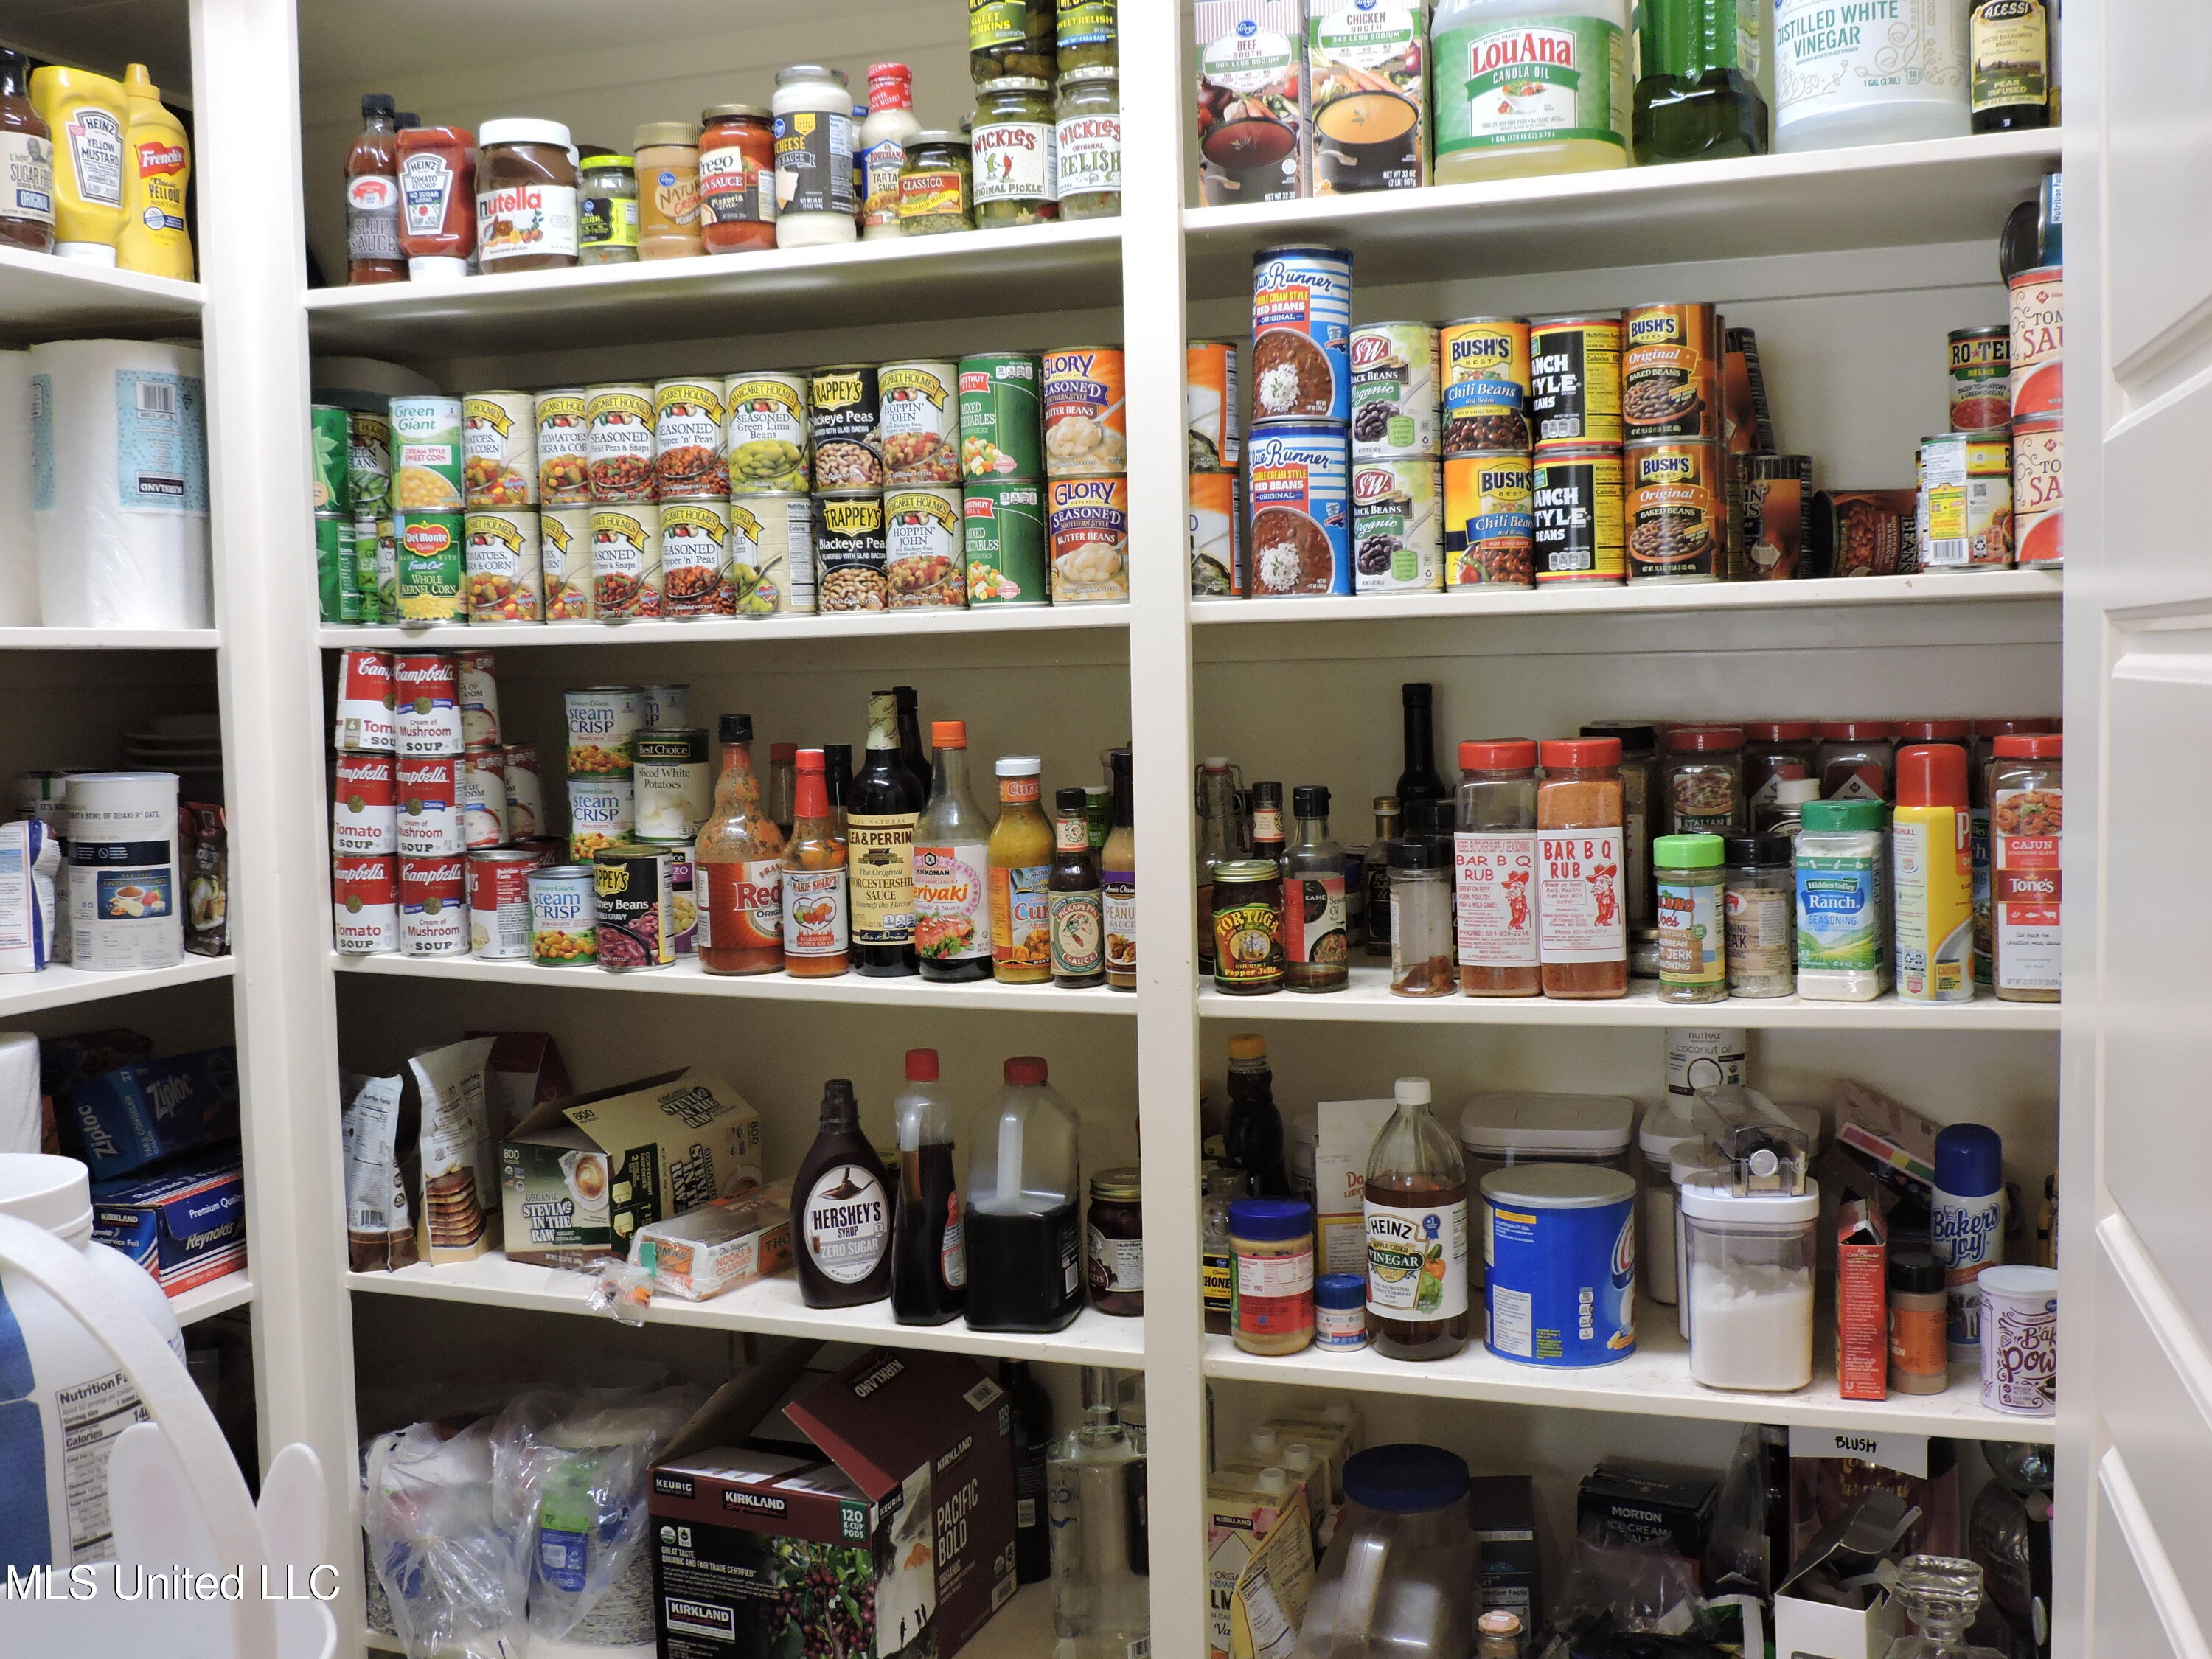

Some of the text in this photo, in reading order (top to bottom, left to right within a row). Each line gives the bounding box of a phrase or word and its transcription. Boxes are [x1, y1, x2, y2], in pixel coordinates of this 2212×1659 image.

[1984, 2, 2029, 20] ALESSI
[972, 13, 1000, 26] SWEET
[1079, 15, 1112, 24] RELISH
[1347, 12, 1385, 26] CHICKEN
[1778, 0, 1899, 46] DISTILLED WHITE
[1351, 24, 1382, 32] BROTH
[1237, 40, 1256, 50] BEEF
[1794, 27, 1860, 58] VINEGAR
[1233, 49, 1262, 59] BROTH
[1252, 56, 1279, 65] SODIUM
[1473, 33, 1572, 75] LouAna
[1493, 66, 1550, 84] CANOLA OIL
[86, 118, 115, 136] HEINZ
[777, 137, 805, 153] CHEESE
[141, 150, 184, 168] French's
[411, 161, 437, 171] HEINZ
[411, 175, 437, 184] TOMATO
[711, 175, 742, 189] SAUCE
[903, 177, 942, 190] CLASSICO
[480, 186, 542, 217] nutella
[1268, 262, 1332, 291] Runner
[1632, 319, 1674, 334] BUSH'S
[1453, 338, 1509, 358] BUSH'S
[1629, 349, 1679, 361] Original
[1368, 371, 1398, 380] BEANS
[1629, 369, 1680, 381] BAKED BEANS
[732, 384, 796, 403] MARGARET HOLMES
[1449, 383, 1515, 400] Chili Beans
[395, 405, 434, 417] Green
[846, 411, 874, 422] Peas
[889, 413, 916, 422] JOHN
[1067, 406, 1093, 416] BEANS
[399, 419, 436, 431] Giant
[737, 414, 790, 423] SEASONED
[737, 422, 790, 431] Green Lima
[750, 431, 777, 439] Beans
[1644, 457, 1689, 473] BUSH'S
[1055, 482, 1115, 506] GLORY
[1641, 489, 1694, 501] Original
[1371, 506, 1401, 514] BEANS
[1053, 509, 1120, 527] SEASONED
[1476, 516, 1507, 529] Chili
[406, 533, 447, 543] Del Monte
[820, 538, 863, 550] Blackeye
[1058, 533, 1115, 544] BUTTER BEANS
[569, 706, 613, 720] steam
[400, 726, 451, 737] Mushroom
[571, 720, 613, 733] CRISP
[407, 742, 443, 751] SOUP
[639, 745, 689, 754] Best Choice
[644, 779, 681, 789] Potatoes
[574, 795, 619, 808] steam
[574, 808, 619, 821] CRISP
[340, 839, 373, 849] SOUP
[402, 843, 433, 852] SOUP
[1544, 840, 1610, 860] BAR B Q
[2011, 841, 2052, 849] CAJUN
[1457, 855, 1531, 867] BAR B Q
[1465, 869, 1494, 880] RUB
[1551, 862, 1580, 878] RUB
[1832, 881, 1856, 891] Valley
[2010, 878, 2053, 893] Tone's
[533, 892, 580, 905] steam
[866, 891, 896, 900] SAUCE
[1809, 895, 1855, 908] Ranch
[616, 900, 648, 909] Beans
[1057, 903, 1098, 919] PICKAPEPPA
[535, 905, 580, 918] CRISP
[1217, 911, 1279, 935] TORTUGA
[1809, 916, 1856, 925] SEASONING
[408, 925, 459, 936] Mushroom
[341, 940, 373, 950] SOUP
[415, 941, 452, 950] SOUP
[1067, 954, 1095, 963] SAUCE
[1668, 949, 1691, 959] JERK
[1225, 967, 1276, 976] Pepper Jelly
[1938, 967, 1961, 975] CAUTION
[1677, 1044, 1732, 1054] coconut oil
[78, 1105, 119, 1161] Ziploc
[504, 1149, 520, 1161] 800
[526, 1192, 559, 1201] ORGANIC
[189, 1203, 220, 1219] Premium
[523, 1202, 563, 1217] STEVIA
[813, 1201, 882, 1230] HERSHEY'S
[532, 1216, 572, 1229] IN THE
[1371, 1219, 1413, 1239] HEINZ
[185, 1222, 232, 1251] Reynolds
[530, 1229, 555, 1243] RAW
[838, 1226, 858, 1239] SYRUP
[127, 1239, 139, 1247] Foil
[821, 1239, 878, 1257] ZERO SUGAR
[1369, 1252, 1419, 1267] VINEGAR
[59, 1379, 115, 1405] Nutrition
[66, 1428, 103, 1447] Calories
[1835, 1436, 1877, 1453] BLUSH
[656, 1479, 692, 1492] KEURIG
[725, 1492, 785, 1511] KIRKLAND
[937, 1478, 978, 1536] PACIFIC
[843, 1509, 863, 1523] 120
[1613, 1506, 1661, 1521] MORTON
[844, 1528, 863, 1539] PODS
[939, 1523, 967, 1568] BOLD
[662, 1555, 684, 1565] ORGANIC
[686, 1558, 695, 1566] AND
[697, 1560, 709, 1569] FAIR
[710, 1563, 726, 1573] TRADE
[672, 1603, 730, 1621] KIRKLAND
